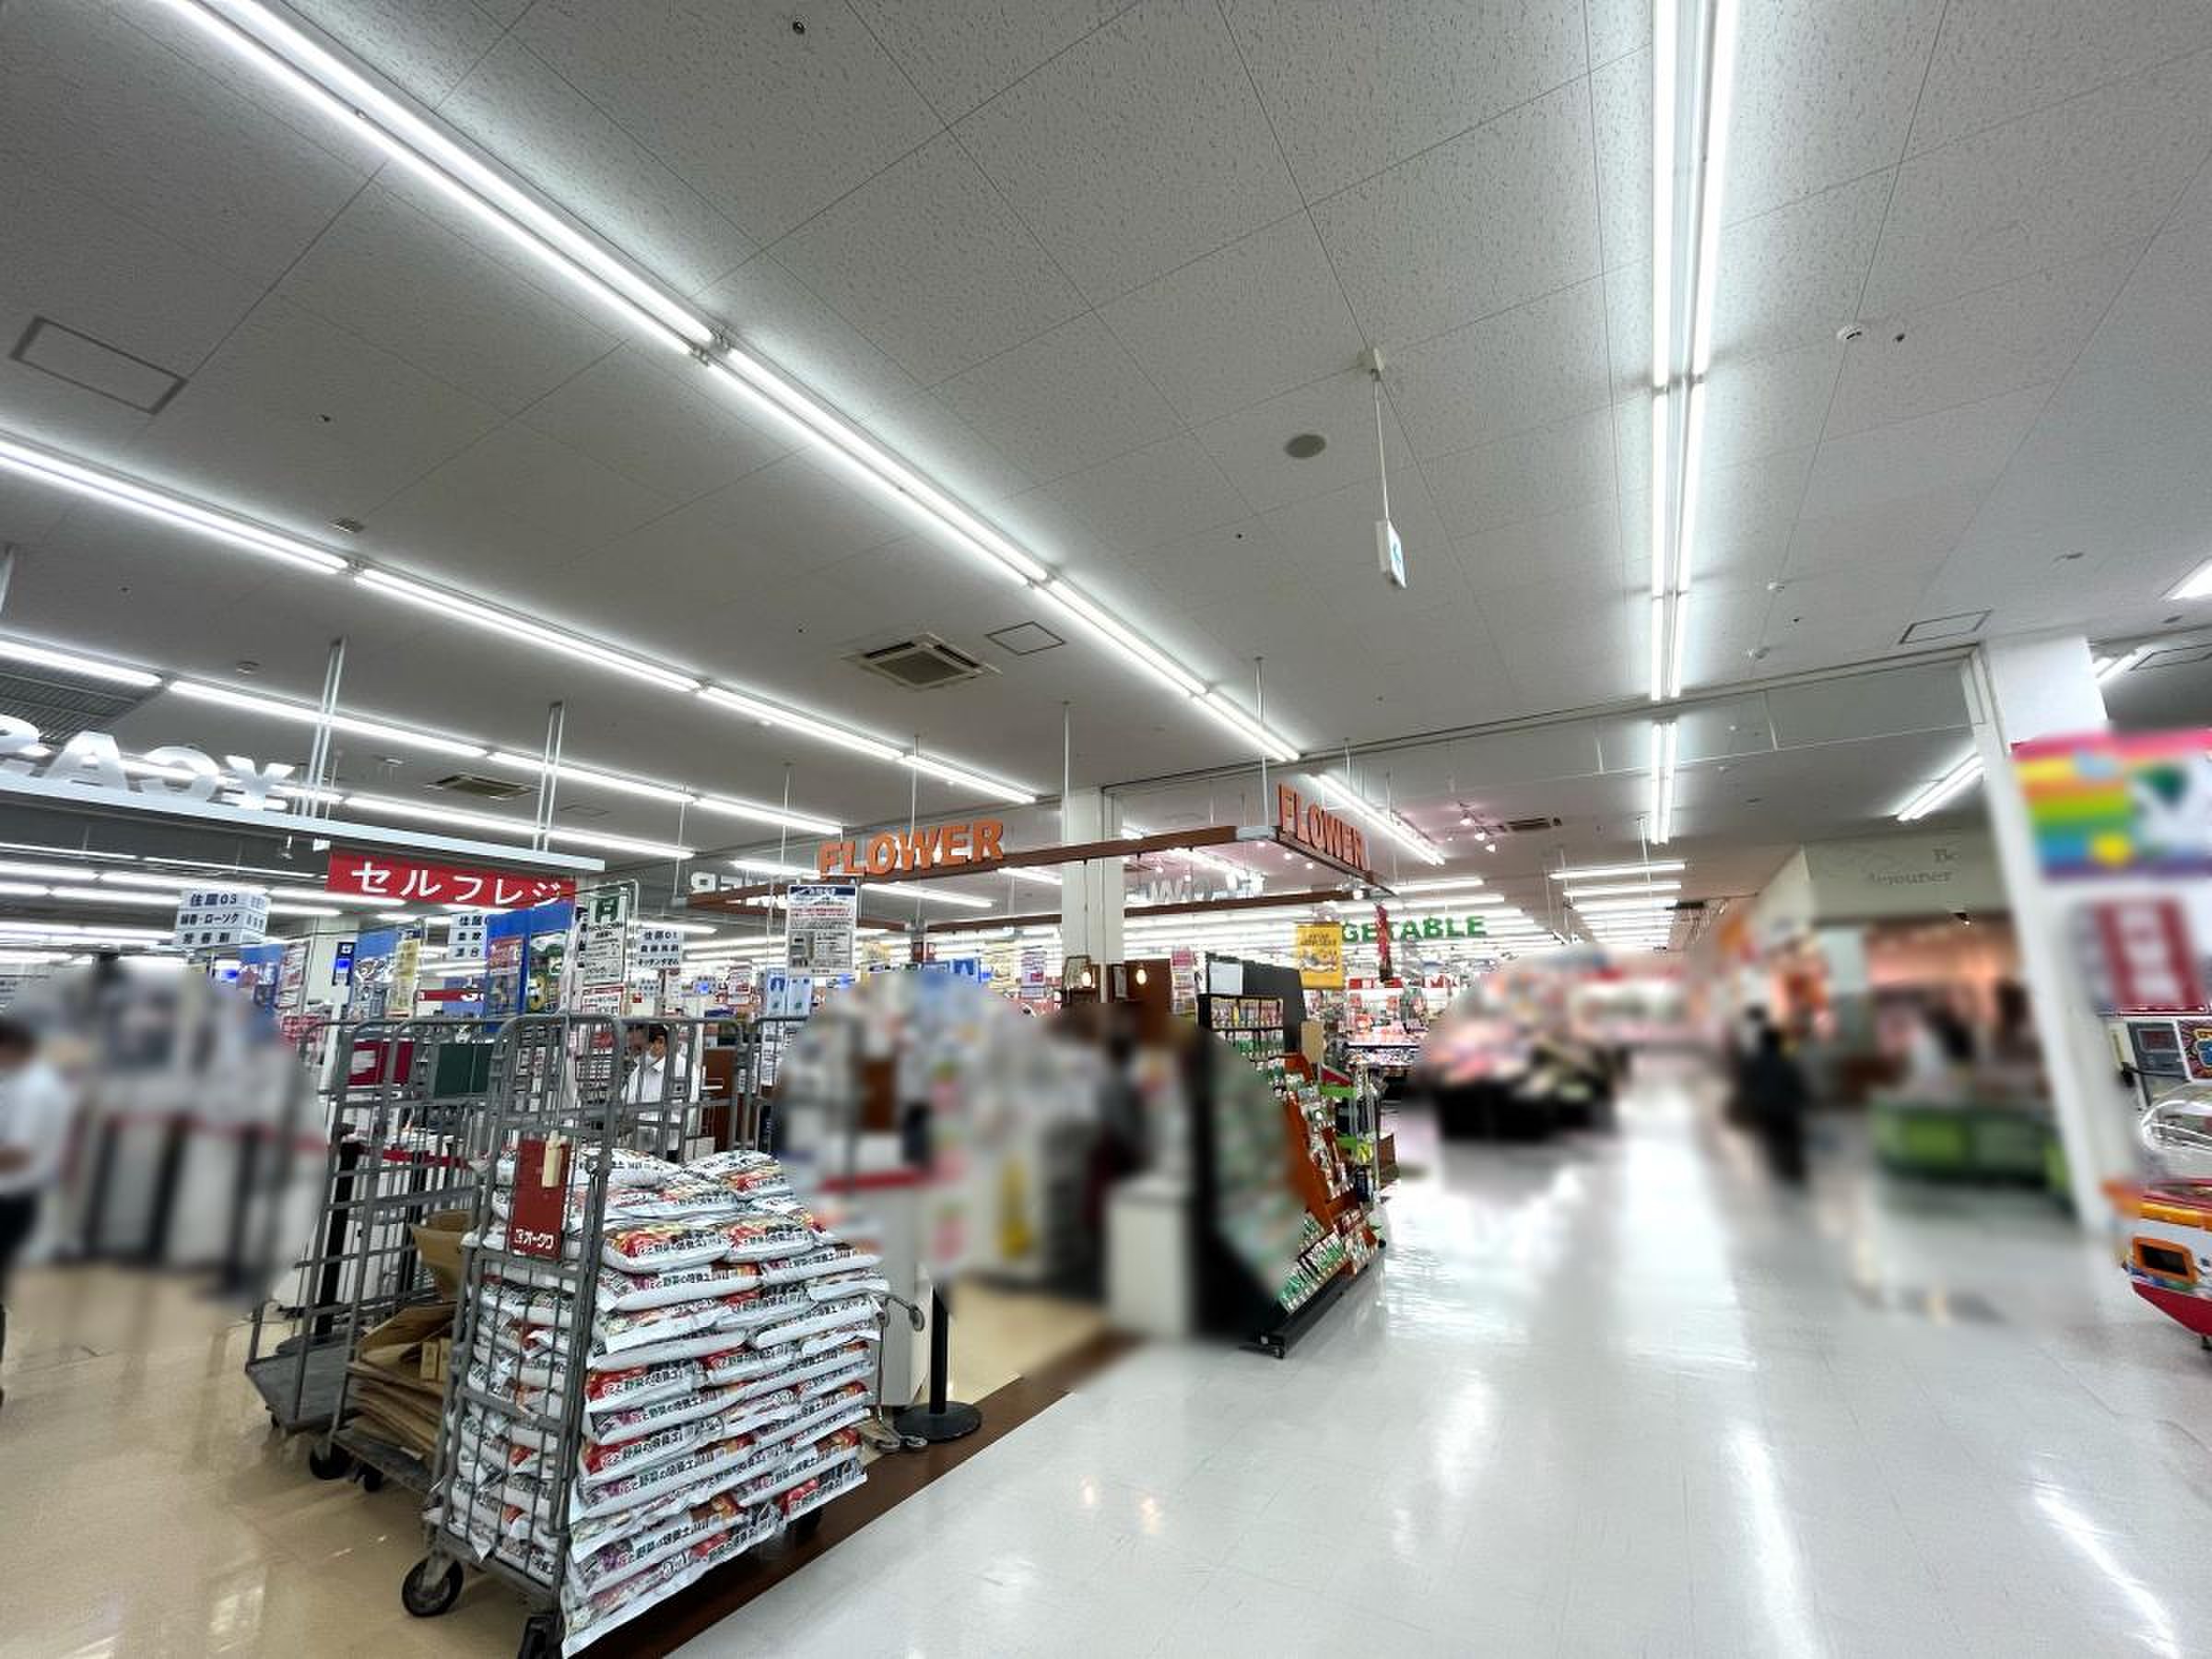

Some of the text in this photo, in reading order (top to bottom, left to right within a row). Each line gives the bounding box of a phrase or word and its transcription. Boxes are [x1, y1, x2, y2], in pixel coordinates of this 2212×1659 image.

[818, 818, 1004, 876] FLOWER
[1277, 783, 1364, 871] FLOWER
[350, 862, 561, 907] セルフレジ
